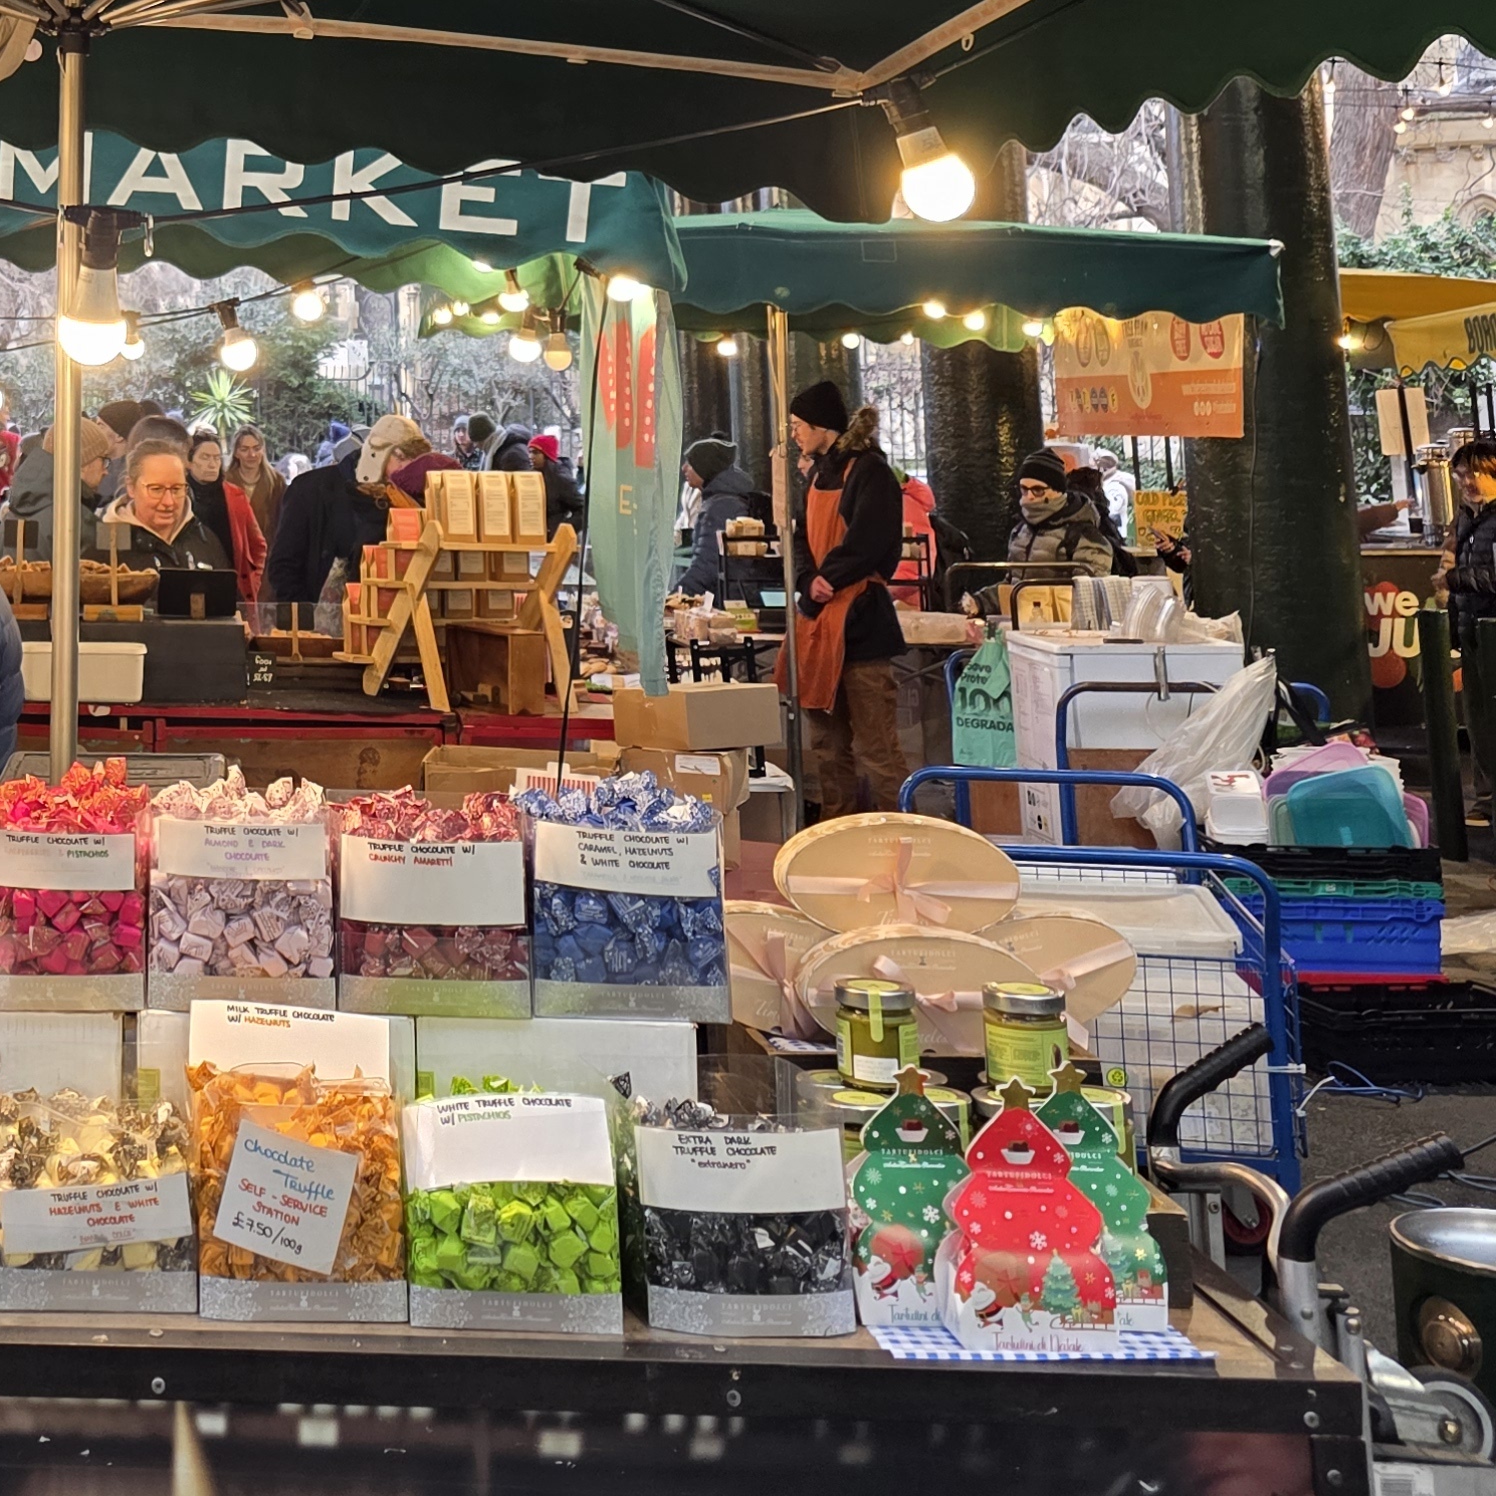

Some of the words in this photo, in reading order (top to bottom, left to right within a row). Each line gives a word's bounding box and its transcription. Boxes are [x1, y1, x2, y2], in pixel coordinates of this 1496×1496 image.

[1364, 591, 1419, 616] we
[204, 826, 236, 835] TRUFFLE
[243, 827, 282, 836] CHOCOLATE
[6, 835, 39, 844] TRUFFLE
[47, 836, 88, 845] CHOCOLATE
[204, 838, 238, 848] ALMOND
[262, 840, 285, 848] DARK
[576, 831, 614, 841] TRUFFLE
[624, 835, 669, 844] CHOCOLATE
[368, 842, 404, 852] TRUFFLE
[411, 846, 455, 854] CHOCOLATE
[625, 847, 673, 856] HAZELNUTS
[225, 852, 270, 861] CHOCOLATE
[369, 854, 406, 864] CRUNCHY
[414, 856, 453, 866] AMARETTI
[592, 858, 620, 867] WHITE
[629, 861, 670, 870] CHOCOLATE
[227, 1005, 250, 1013] MILK
[255, 1007, 288, 1018] TRUFFLE
[292, 1011, 335, 1022] CHOCOLATE
[244, 1017, 291, 1028] HAZELNUTS
[437, 1103, 470, 1114] WHITE
[475, 1098, 515, 1108] TRUFFLE
[522, 1098, 572, 1107] CHOCOLATE
[458, 1110, 512, 1123] PISTACHIOS
[678, 1134, 712, 1145] EXTRA
[724, 1136, 752, 1145] DARK
[672, 1145, 716, 1156] TRUFFLE
[726, 1146, 777, 1156] CHOCOLATE
[273, 1169, 335, 1201] Truffle
[51, 1192, 88, 1203] TRUFFLE
[96, 1185, 140, 1199] CHOCOLATE
[238, 1179, 266, 1198] SELF
[280, 1194, 328, 1218] SERVICE
[49, 1202, 102, 1216] HAZELNUTS
[128, 1198, 159, 1209] WHITE
[252, 1202, 300, 1226] STATION
[87, 1214, 135, 1227] CHOCOLATE
